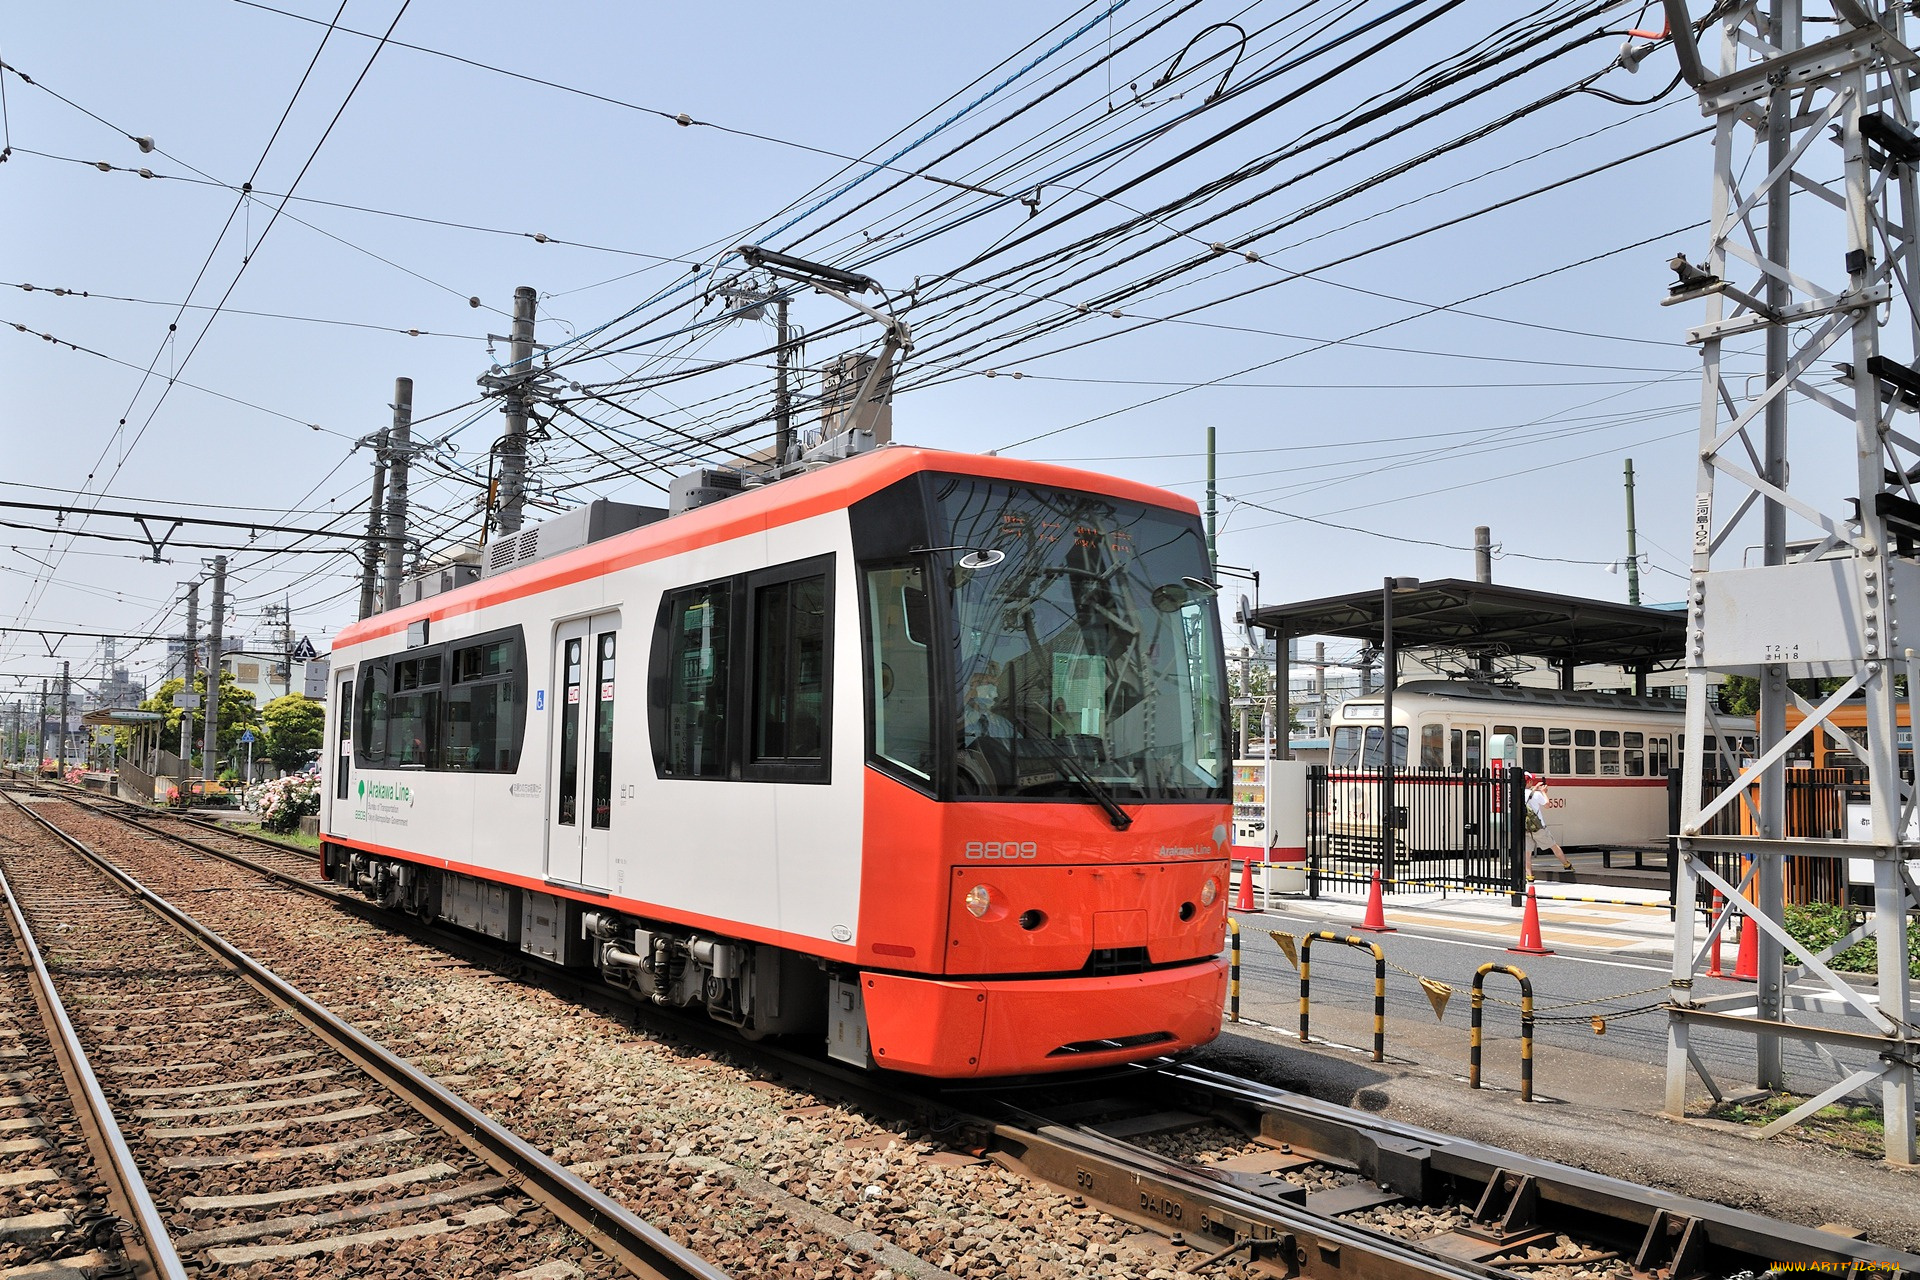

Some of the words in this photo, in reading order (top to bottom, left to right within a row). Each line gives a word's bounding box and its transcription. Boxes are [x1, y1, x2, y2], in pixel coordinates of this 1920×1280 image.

[368, 780, 395, 800] Arakawa
[395, 782, 410, 802] Line
[965, 841, 1037, 859] 8809
[1159, 845, 1195, 857] Arakawa
[1196, 843, 1212, 855] Line
